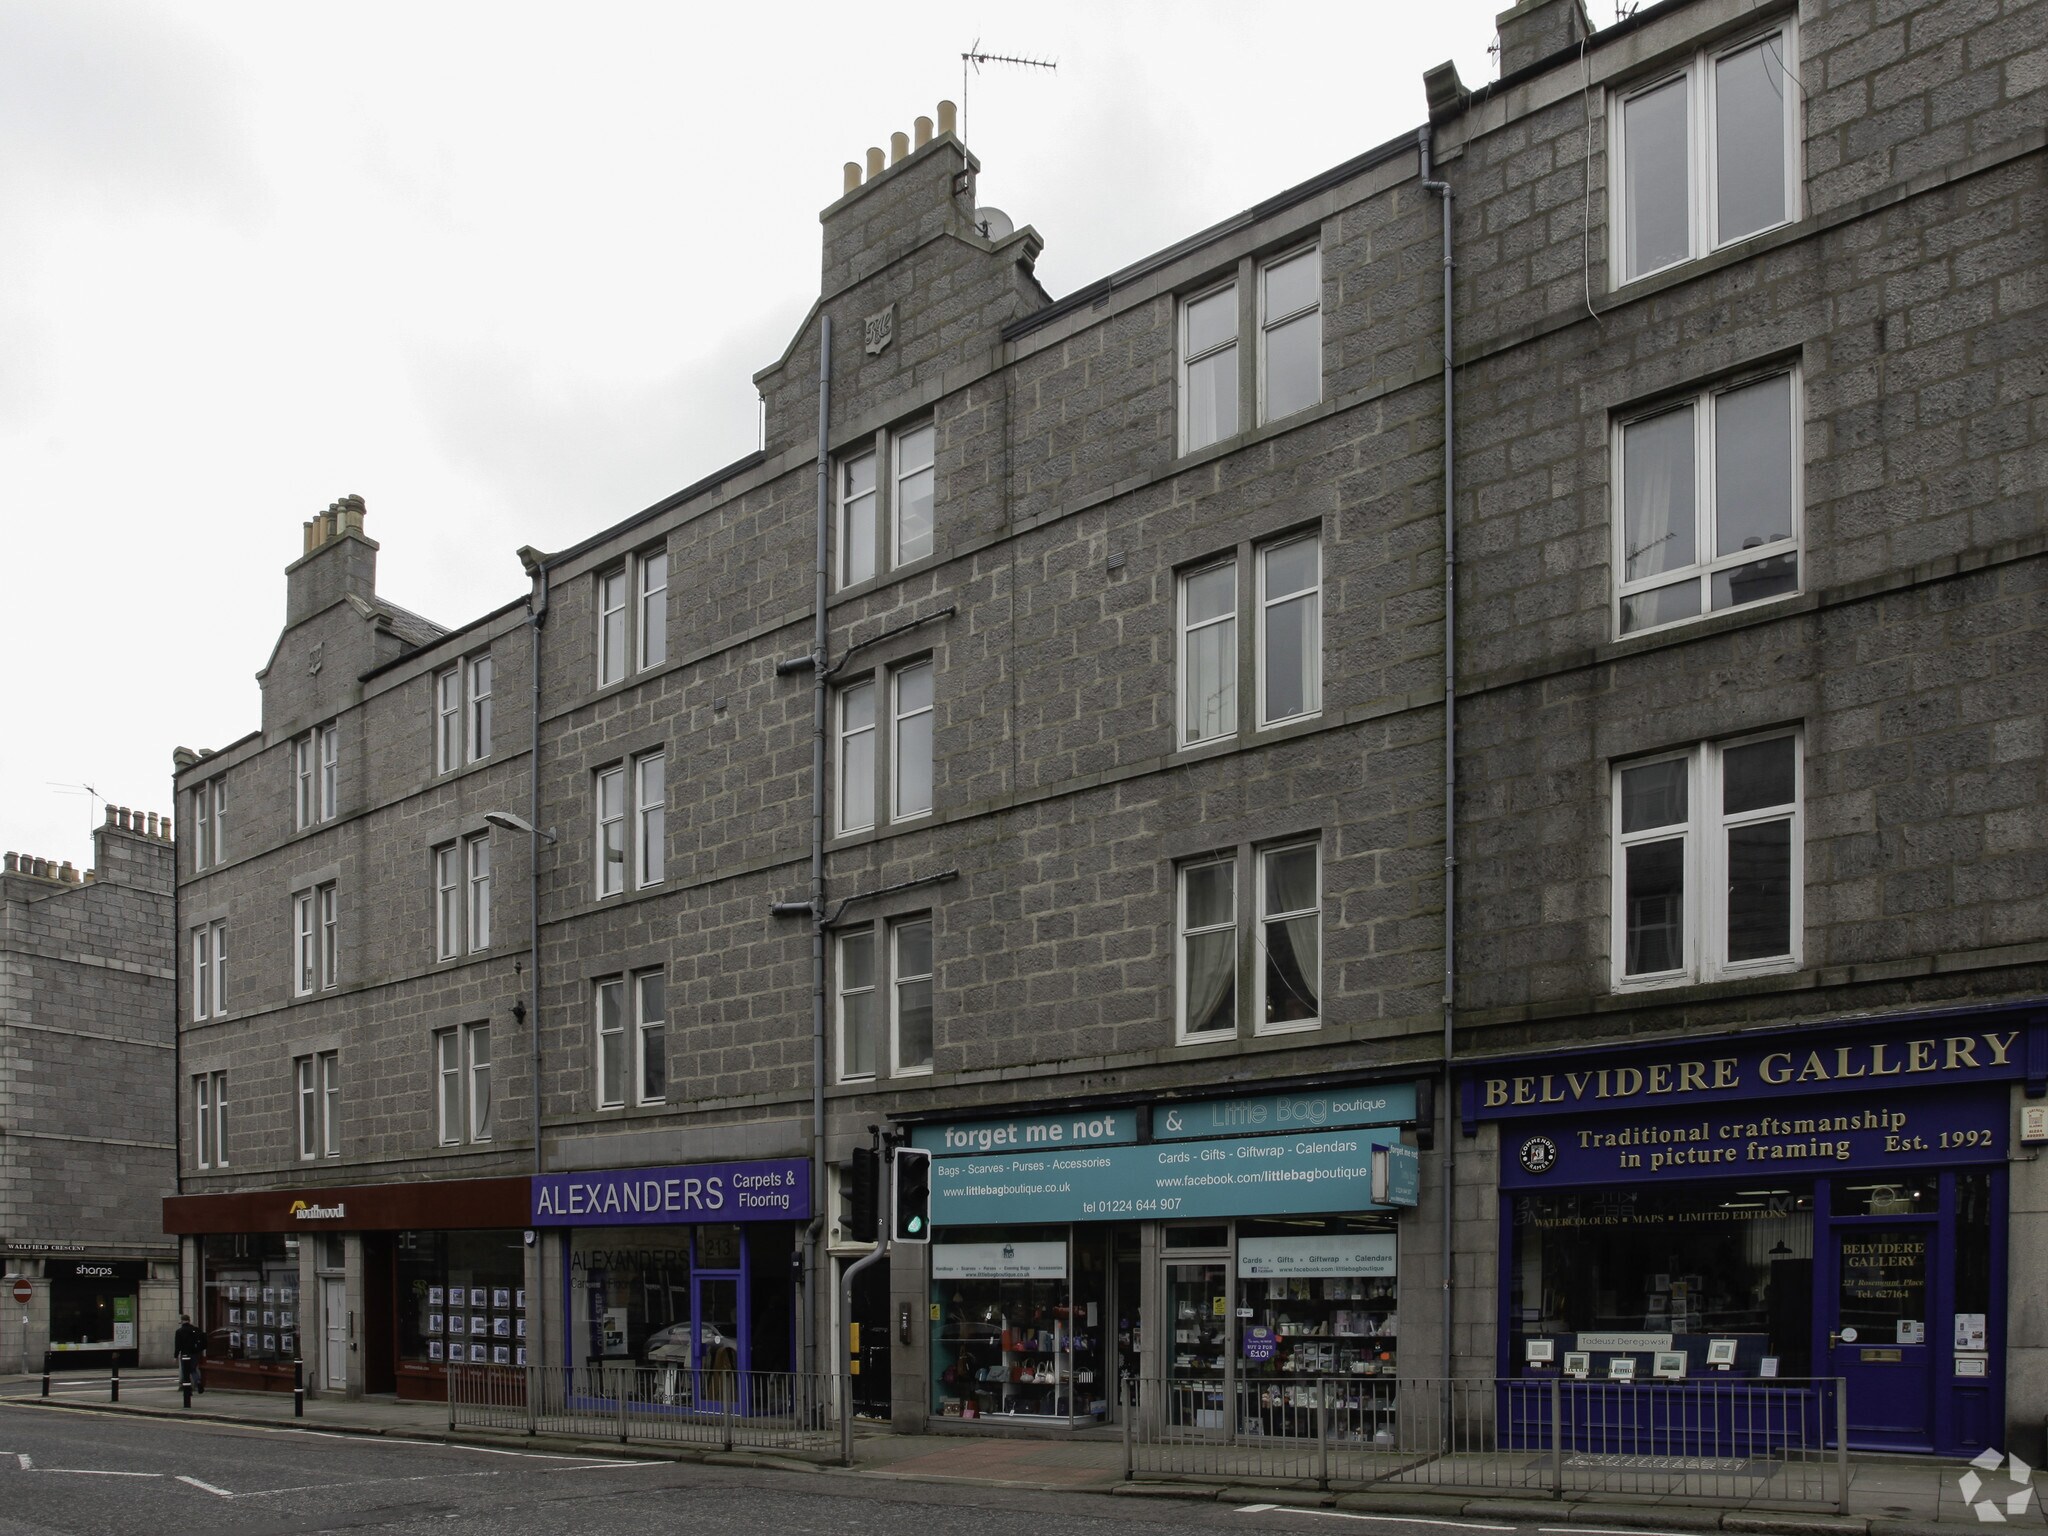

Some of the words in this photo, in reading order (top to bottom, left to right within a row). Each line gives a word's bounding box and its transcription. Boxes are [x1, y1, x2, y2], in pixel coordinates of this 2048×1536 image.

[1483, 1057, 1740, 1107] BELVIDERE
[1758, 1031, 2020, 1085] GALLERY
[1165, 1110, 1183, 1131] &
[1212, 1101, 1268, 1127] Little
[1276, 1097, 1327, 1125] Bag
[1332, 1099, 1386, 1114] boutique
[945, 1123, 1018, 1151] forget
[1026, 1124, 1063, 1142] me
[1072, 1115, 1115, 1140] not
[1577, 1122, 1710, 1149] Traditional
[1719, 1108, 1907, 1140] craftsmanship
[1521, 1138, 1555, 1156] COMMENDED
[1884, 1135, 1929, 1153] Est.
[1938, 1129, 1993, 1149] 1992
[1158, 1152, 1190, 1164] Cards
[1200, 1148, 1226, 1161] Gifts
[1237, 1146, 1284, 1161] Giftwrap
[1295, 1141, 1358, 1154] Calendars
[1620, 1151, 1641, 1168] in
[1650, 1147, 1737, 1172] picture
[1746, 1137, 1851, 1161] framing
[938, 1165, 960, 1178] Bags
[968, 1163, 1004, 1175] Scarves
[1012, 1161, 1044, 1172] Purses
[1052, 1157, 1111, 1170] Accessories
[1156, 1169, 1367, 1188] www.facebook.com/littlebagboutique
[537, 1177, 724, 1215] ALEXANDERS
[733, 1172, 781, 1191] Carpets
[786, 1170, 796, 1186] &
[943, 1181, 1071, 1198] www.littlebagboutique.co.uk
[739, 1192, 789, 1210] Flooring
[1083, 1201, 1096, 1213] tel
[1098, 1199, 1133, 1212] 01224
[1136, 1198, 1156, 1211] 644
[1160, 1197, 1182, 1210] 907
[296, 1203, 345, 1219] northwood
[1534, 1216, 1619, 1228] WATERCOLOURS
[1632, 1213, 1664, 1224] MAPS
[1678, 1211, 1729, 1223] LIMITED
[1732, 1209, 1788, 1221] EDITIONS
[706, 1239, 731, 1256] 213
[1843, 1243, 1925, 1255] BELVIDERE
[571, 1249, 690, 1271] ALEXANDERS
[1309, 1256, 1340, 1264] Giftwrap
[1354, 1254, 1393, 1262] Calendars
[1848, 1256, 1917, 1267] GALLERY
[76, 1264, 112, 1277] sharps
[1856, 1290, 1873, 1298] Tel.
[1875, 1289, 1909, 1298] 627164
[1617, 1337, 1669, 1347] Deregowski
[1250, 1350, 1269, 1358] £10!
